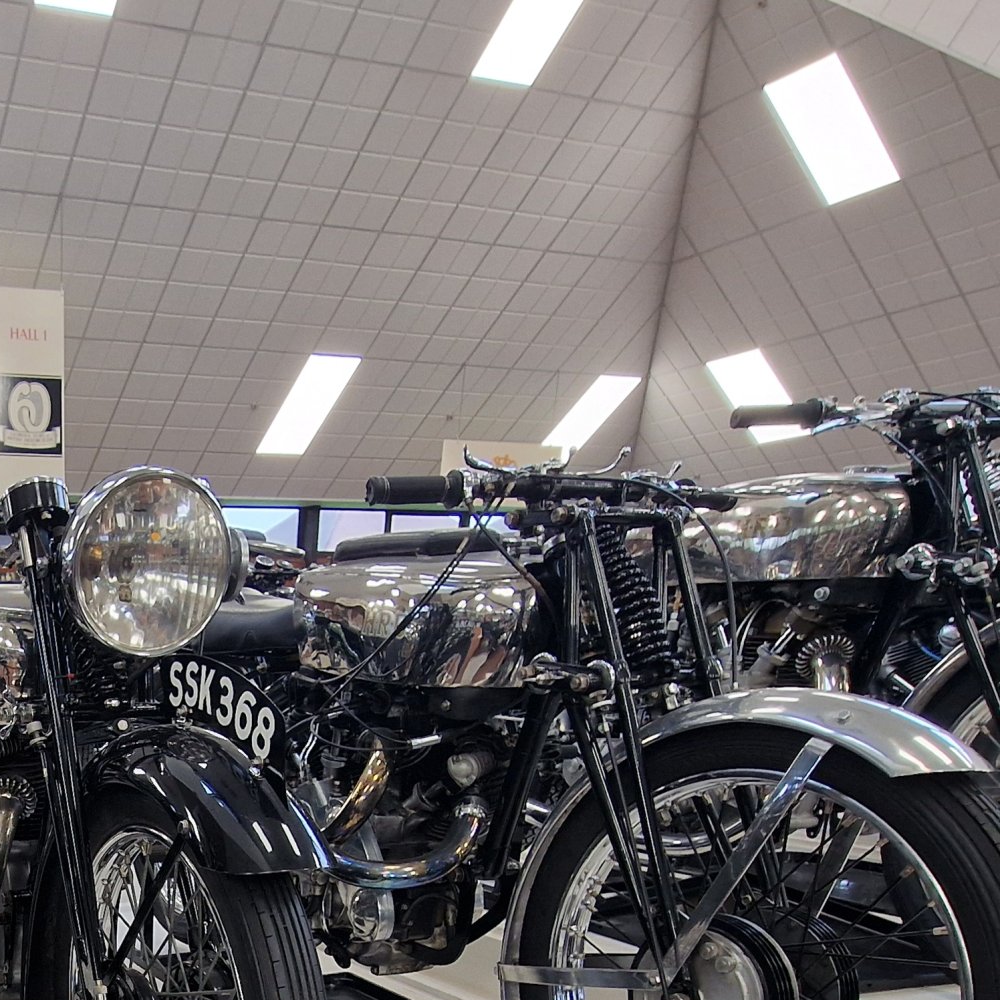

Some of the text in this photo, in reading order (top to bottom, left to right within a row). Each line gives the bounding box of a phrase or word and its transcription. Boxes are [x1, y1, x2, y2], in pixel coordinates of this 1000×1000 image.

[10, 327, 39, 341] HALL
[168, 661, 276, 761] SSK 368
